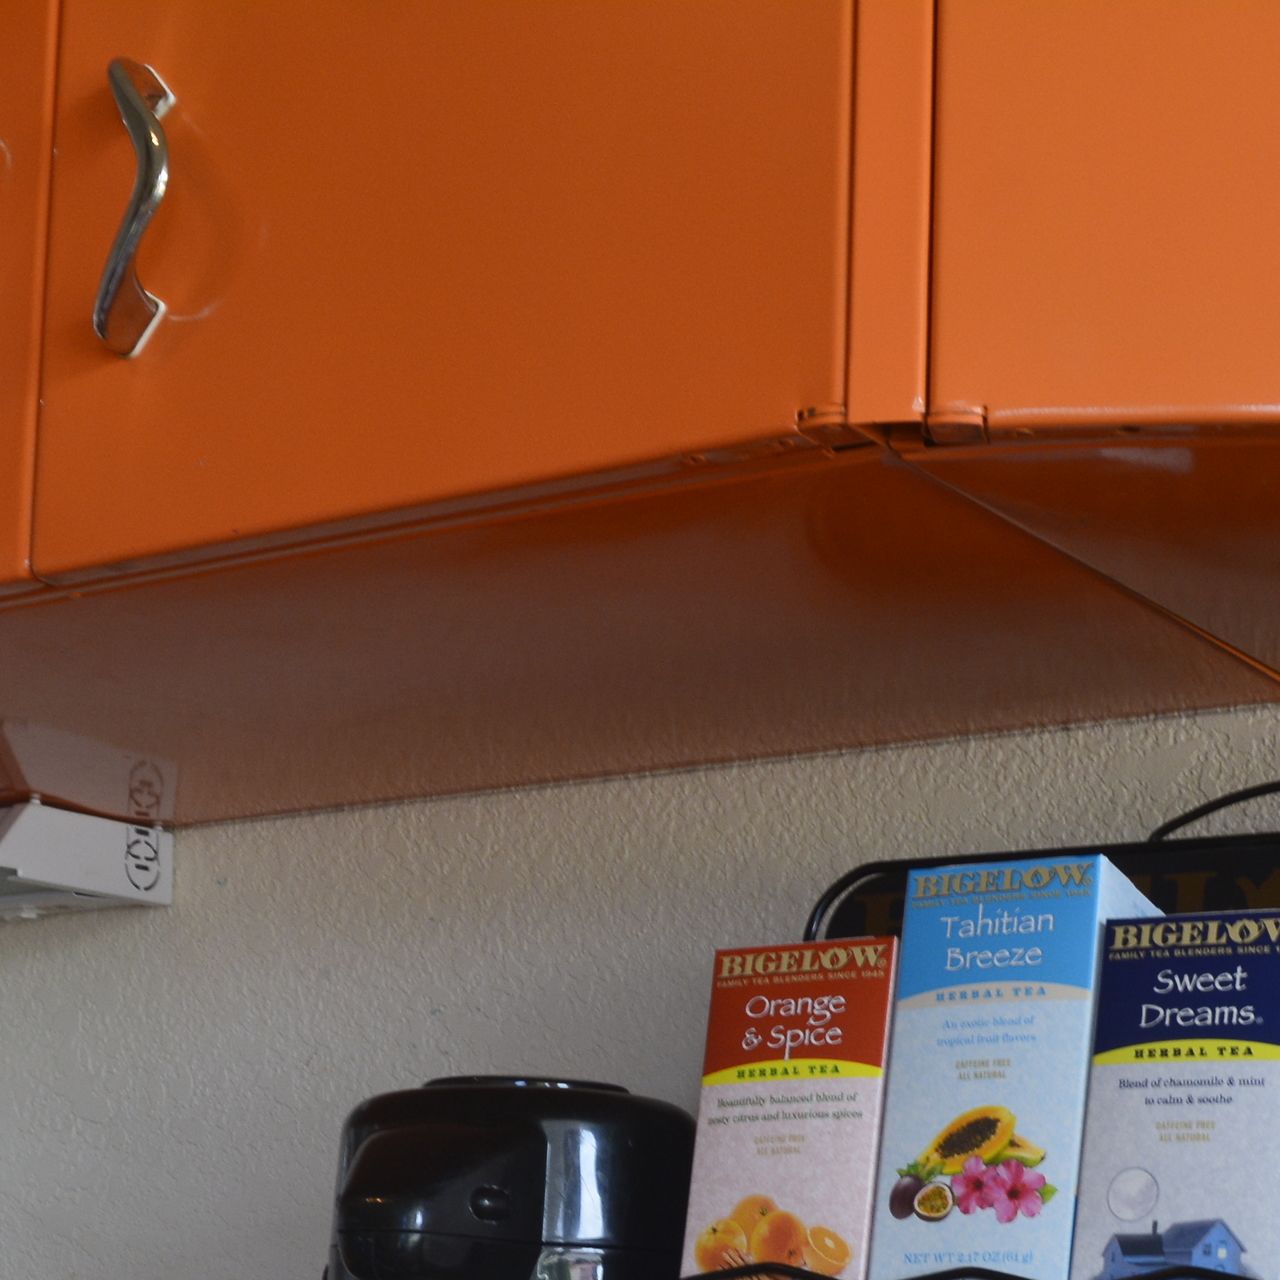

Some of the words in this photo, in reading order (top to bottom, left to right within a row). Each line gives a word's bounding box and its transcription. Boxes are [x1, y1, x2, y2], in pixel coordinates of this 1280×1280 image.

[941, 903, 1054, 938] Tahitian
[945, 947, 1043, 971] Breeze
[1154, 966, 1247, 994] Sweet
[937, 988, 1004, 1001] HERBAL
[1013, 987, 1046, 996] TEA
[746, 995, 846, 1025] Orange
[1140, 1004, 1254, 1028] Dreams
[742, 1027, 762, 1050] &
[767, 1025, 843, 1060] Spice
[1134, 1048, 1207, 1058] HERBAL
[1217, 1047, 1253, 1056] TEA
[737, 1066, 800, 1078] HERBAL
[809, 1064, 840, 1074] TEA
